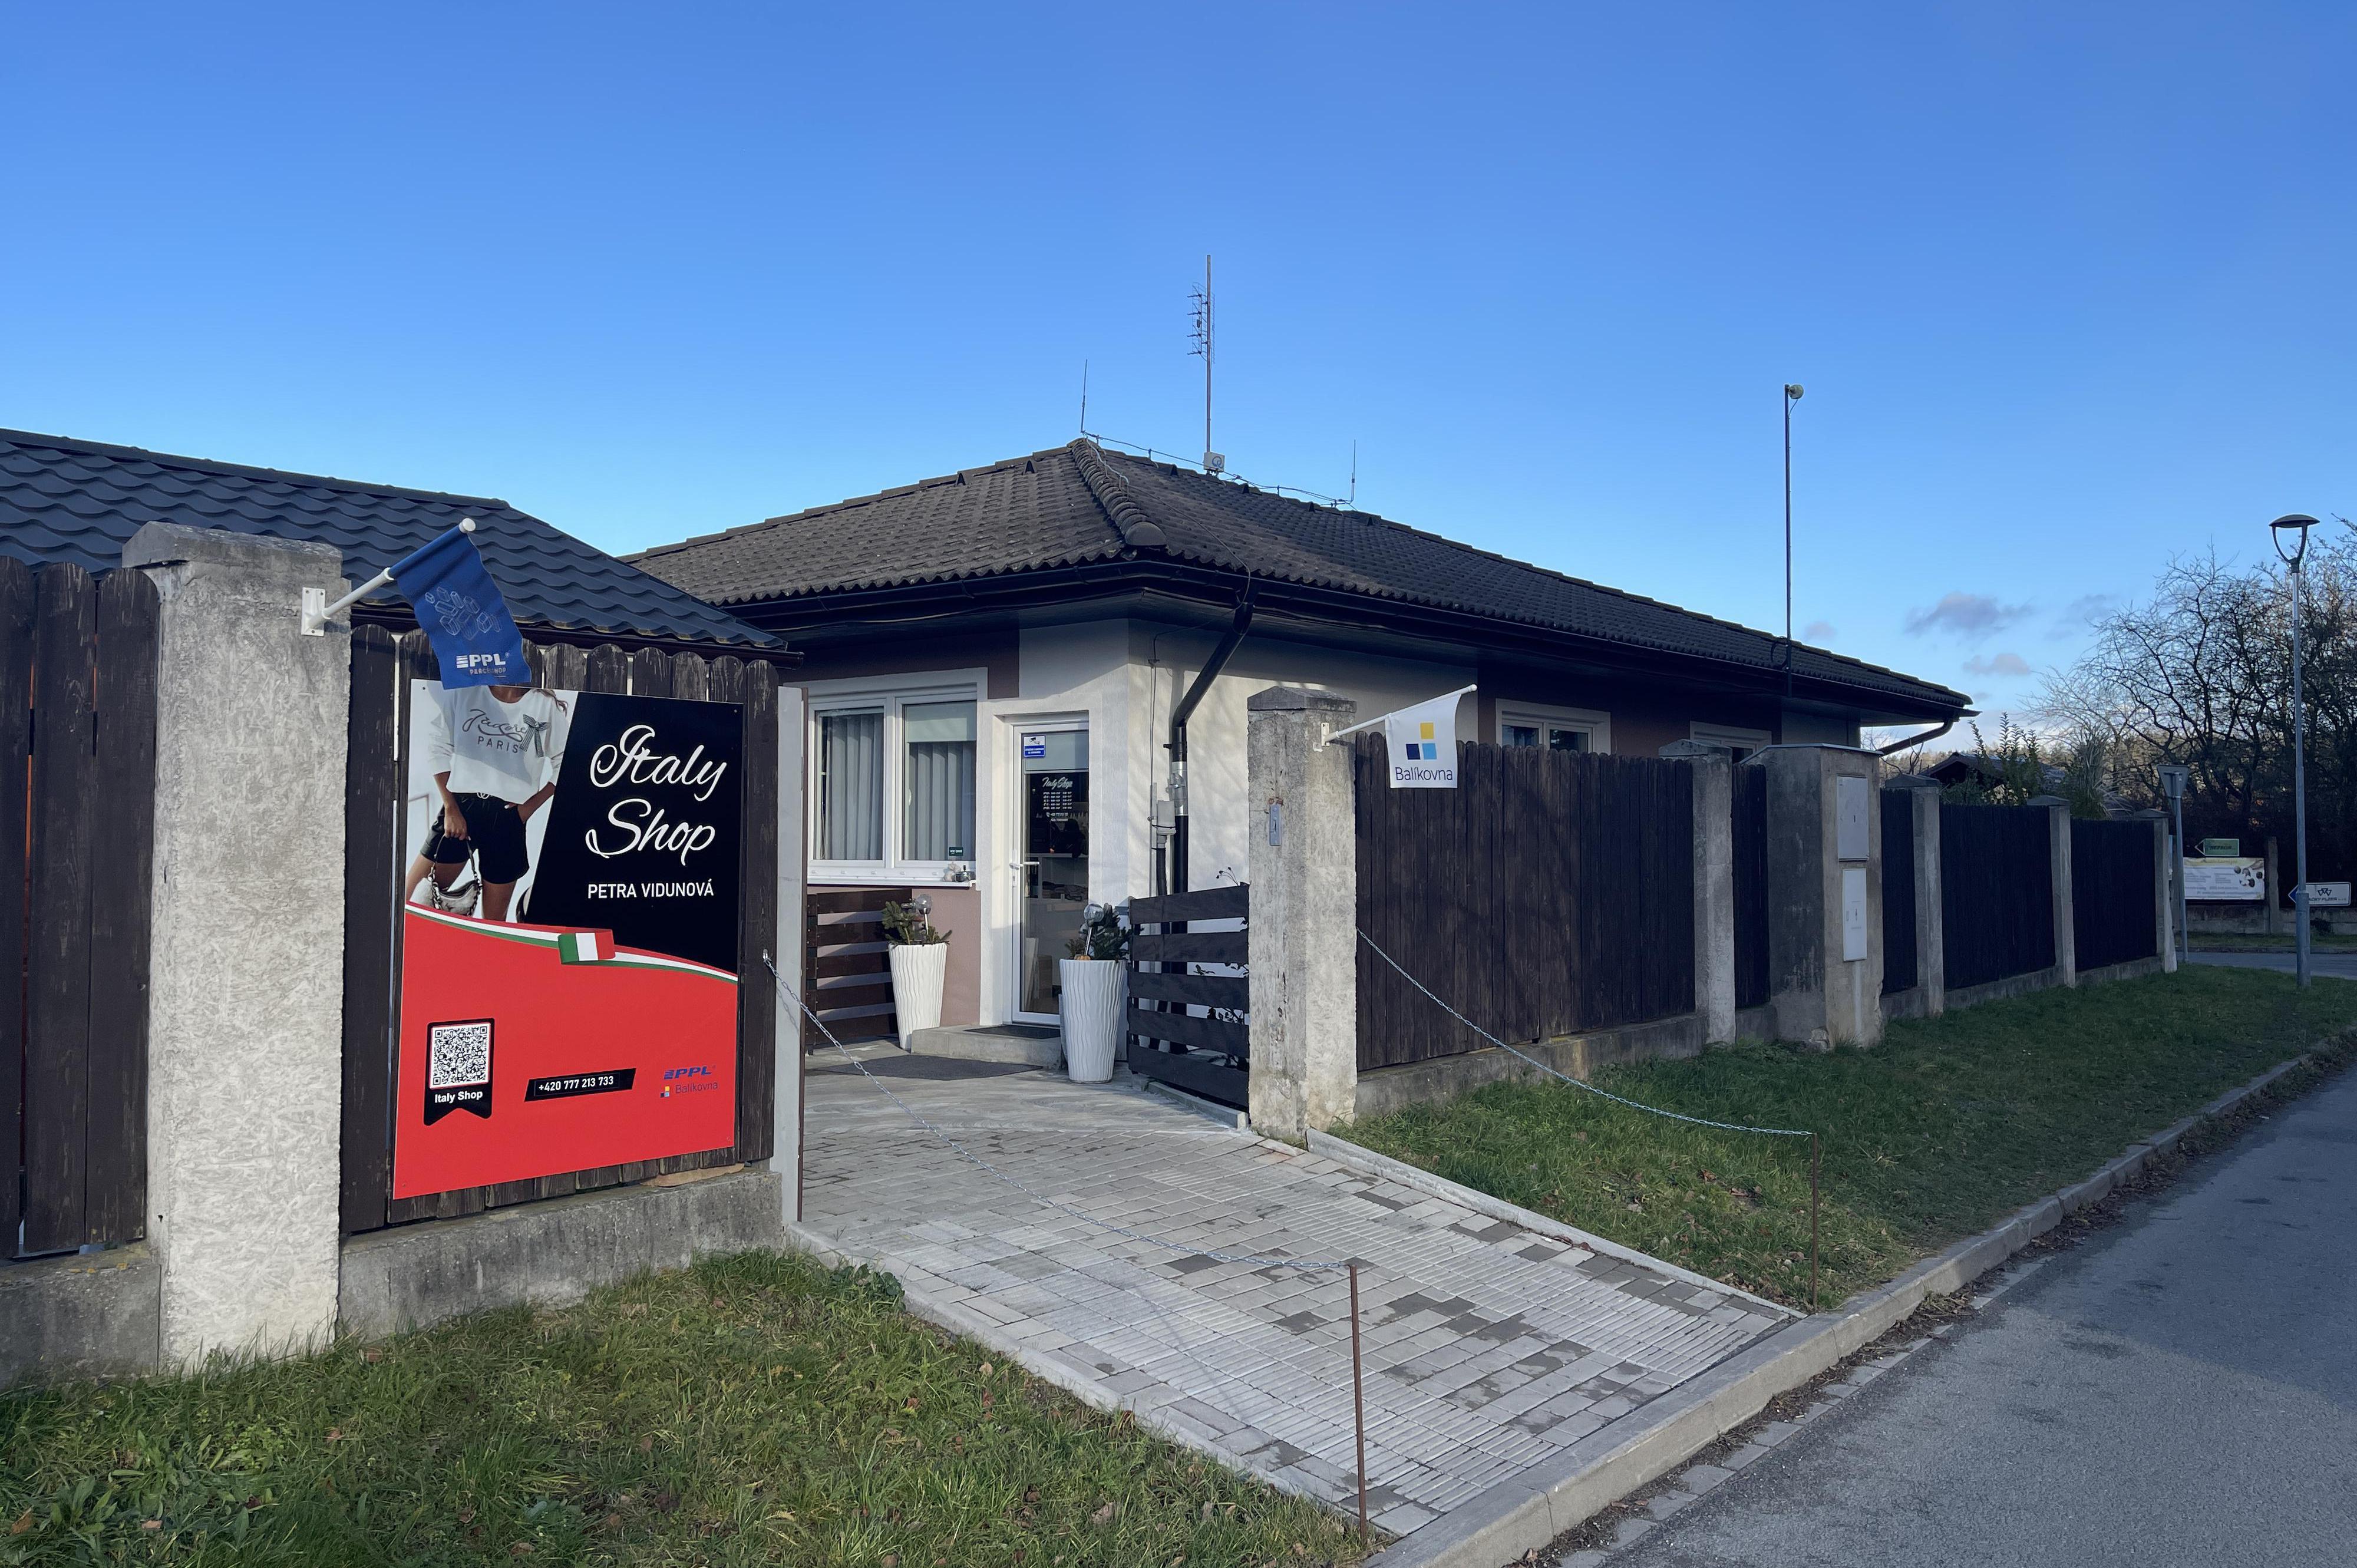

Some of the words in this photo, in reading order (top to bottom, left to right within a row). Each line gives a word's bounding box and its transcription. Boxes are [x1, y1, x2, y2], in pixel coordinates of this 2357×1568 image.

[468, 653, 506, 667] PPL
[477, 736, 519, 753] PARIS
[590, 724, 727, 801] Italy
[1395, 767, 1453, 781] Balíkovna
[585, 798, 715, 866] Shop
[588, 884, 637, 899] PETRA
[641, 879, 714, 897] VIDUNOVÁ
[675, 1066, 712, 1078] PPL
[539, 1081, 561, 1091] +420
[564, 1079, 580, 1090] 777
[582, 1077, 596, 1088] 213
[598, 1075, 614, 1086] 733
[435, 1092, 455, 1104] Italy
[457, 1091, 483, 1101] Shop
